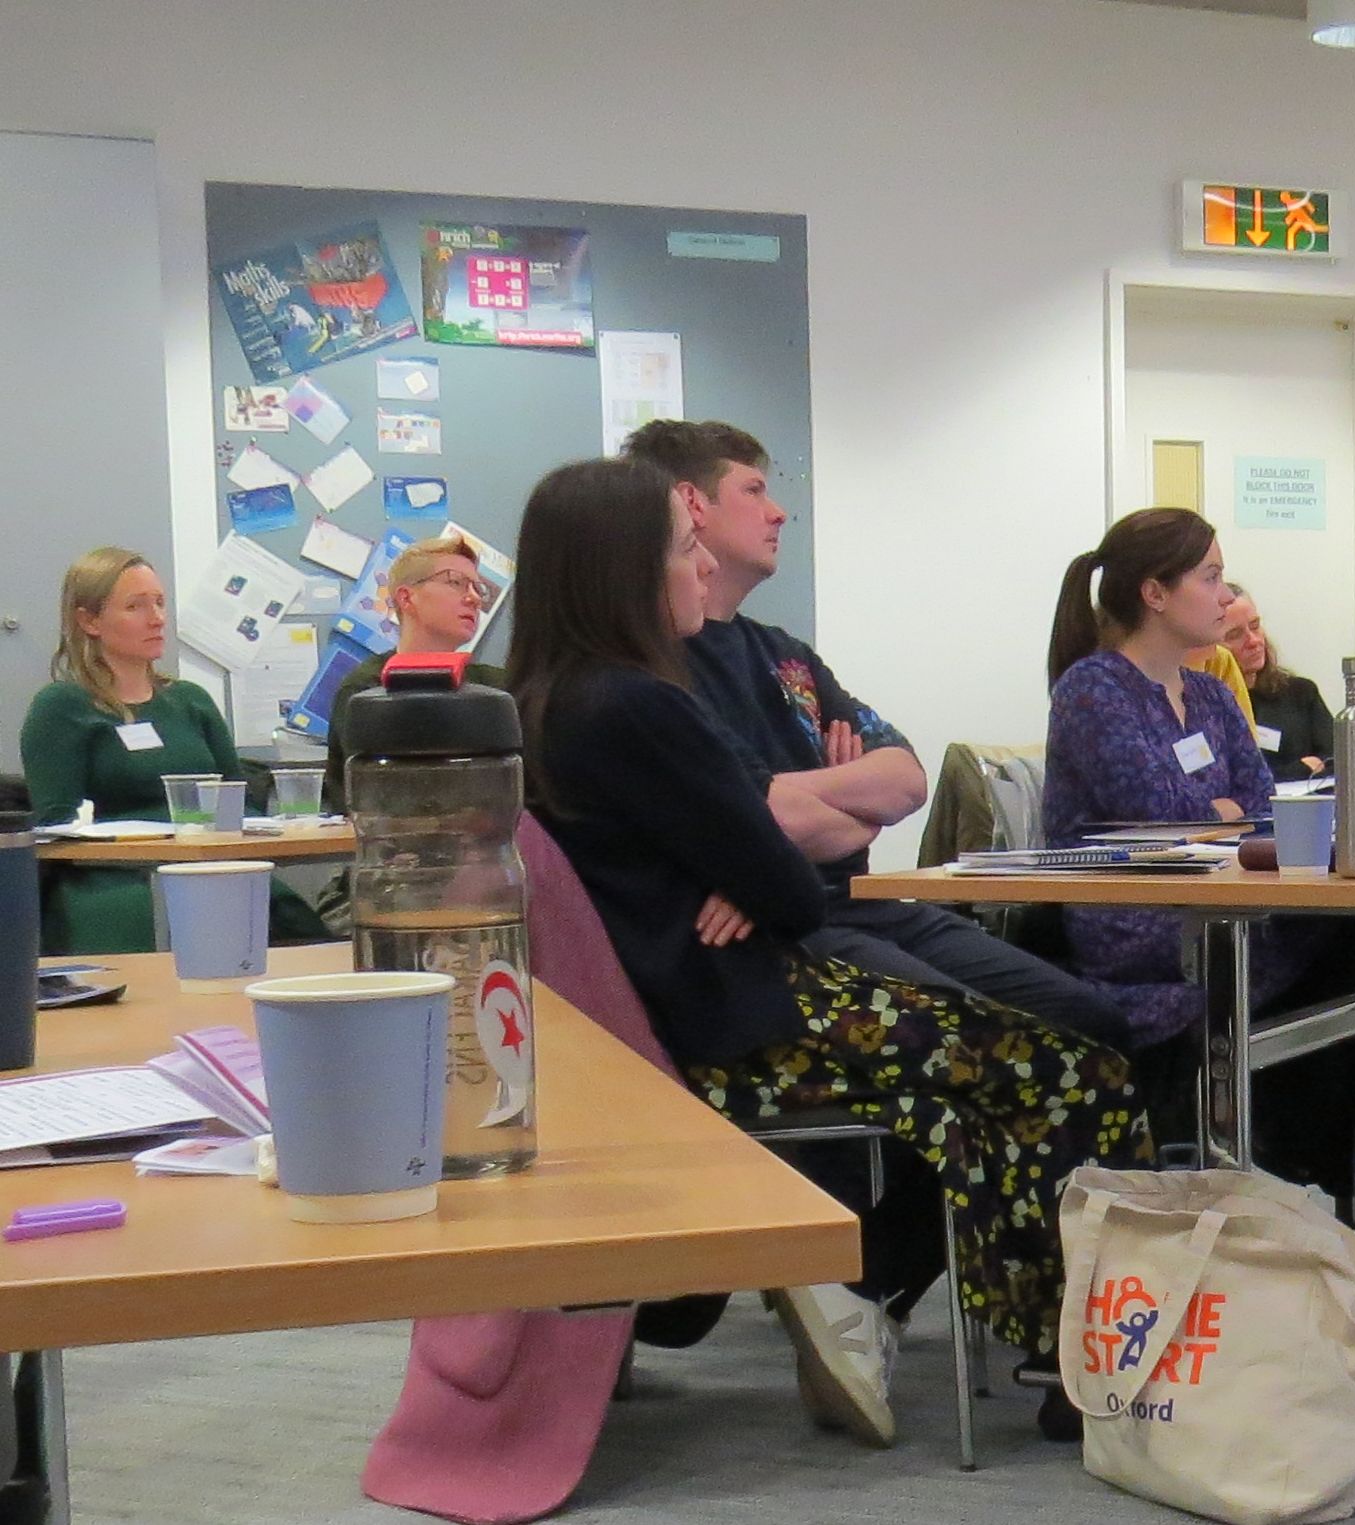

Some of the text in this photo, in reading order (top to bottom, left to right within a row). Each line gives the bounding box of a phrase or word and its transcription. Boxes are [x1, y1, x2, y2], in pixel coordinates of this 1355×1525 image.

[222, 259, 272, 297] Maths
[254, 274, 290, 305] skills
[1250, 468, 1310, 479] PLEASE DO NOT
[1246, 480, 1315, 493] BLOCK THIS DOOR
[1270, 496, 1317, 505] EMERGENCY
